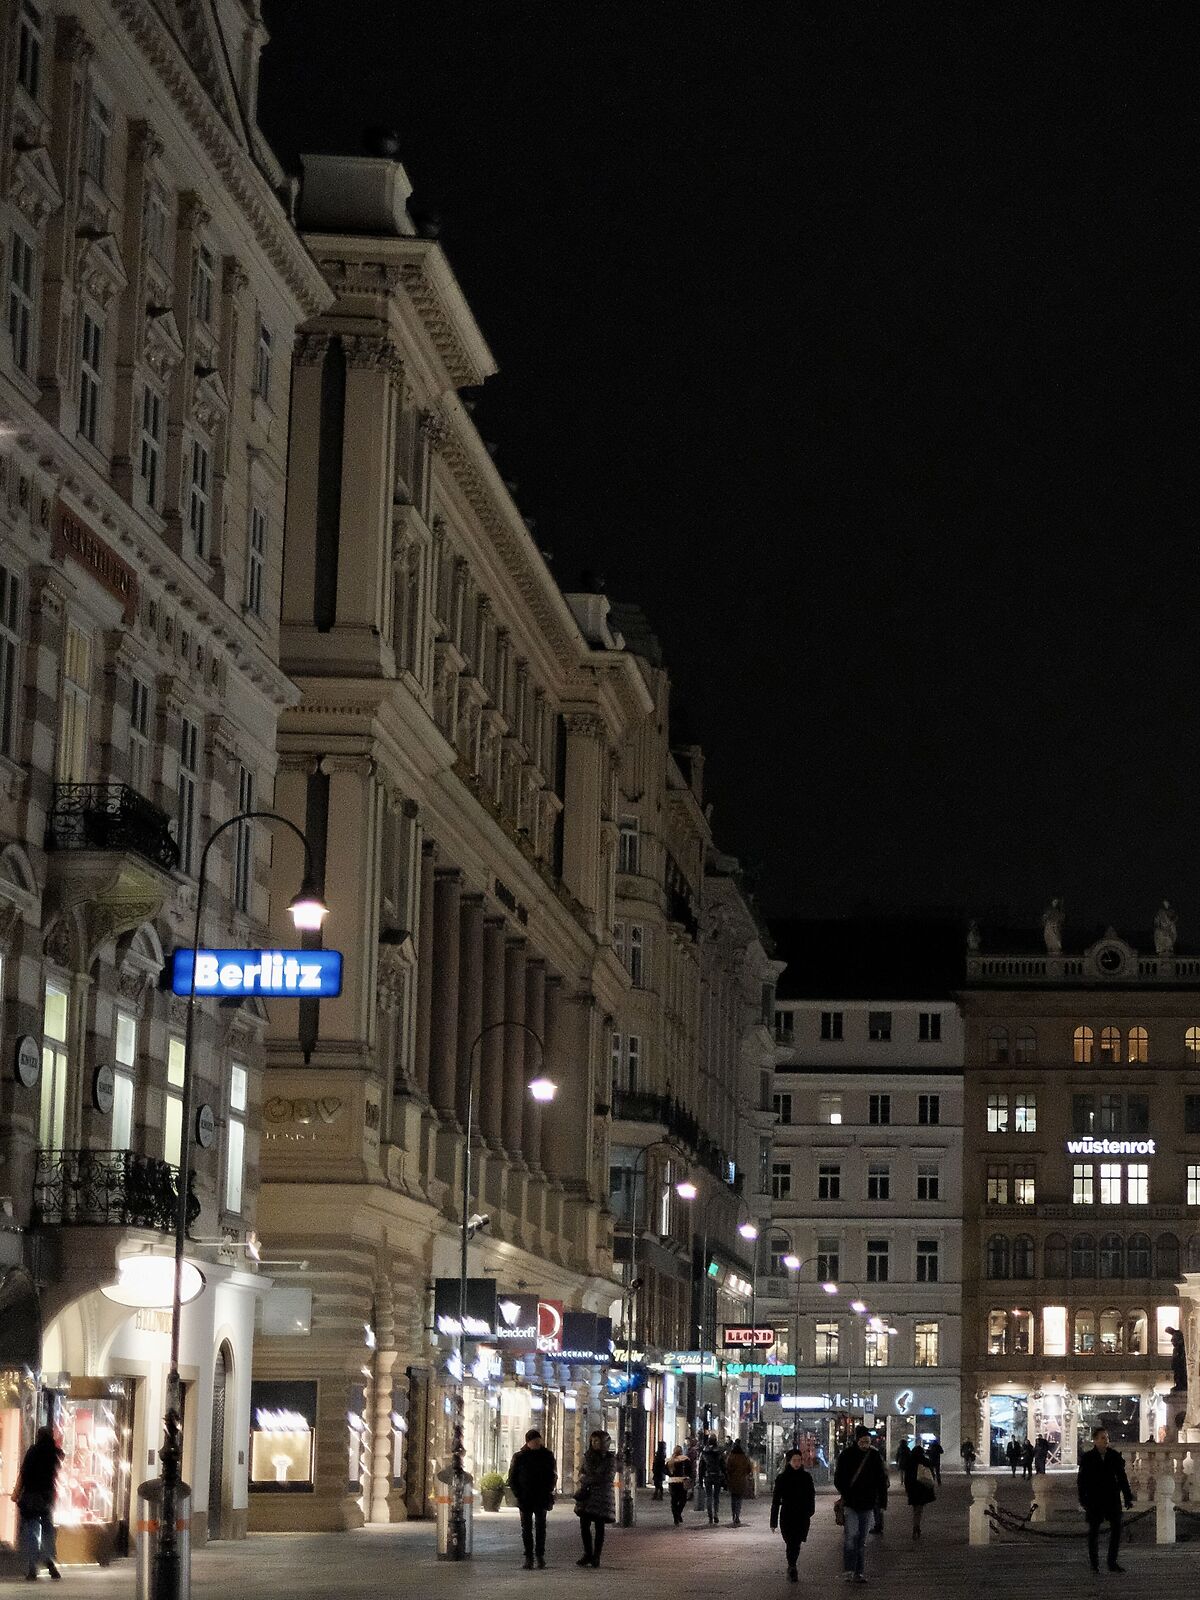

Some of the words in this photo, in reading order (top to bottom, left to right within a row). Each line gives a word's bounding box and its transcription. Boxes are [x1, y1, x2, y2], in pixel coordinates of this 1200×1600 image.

[194, 954, 323, 992] Berlitz
[1067, 1136, 1156, 1155] wüstenrot
[727, 1331, 772, 1342] LLOYD
